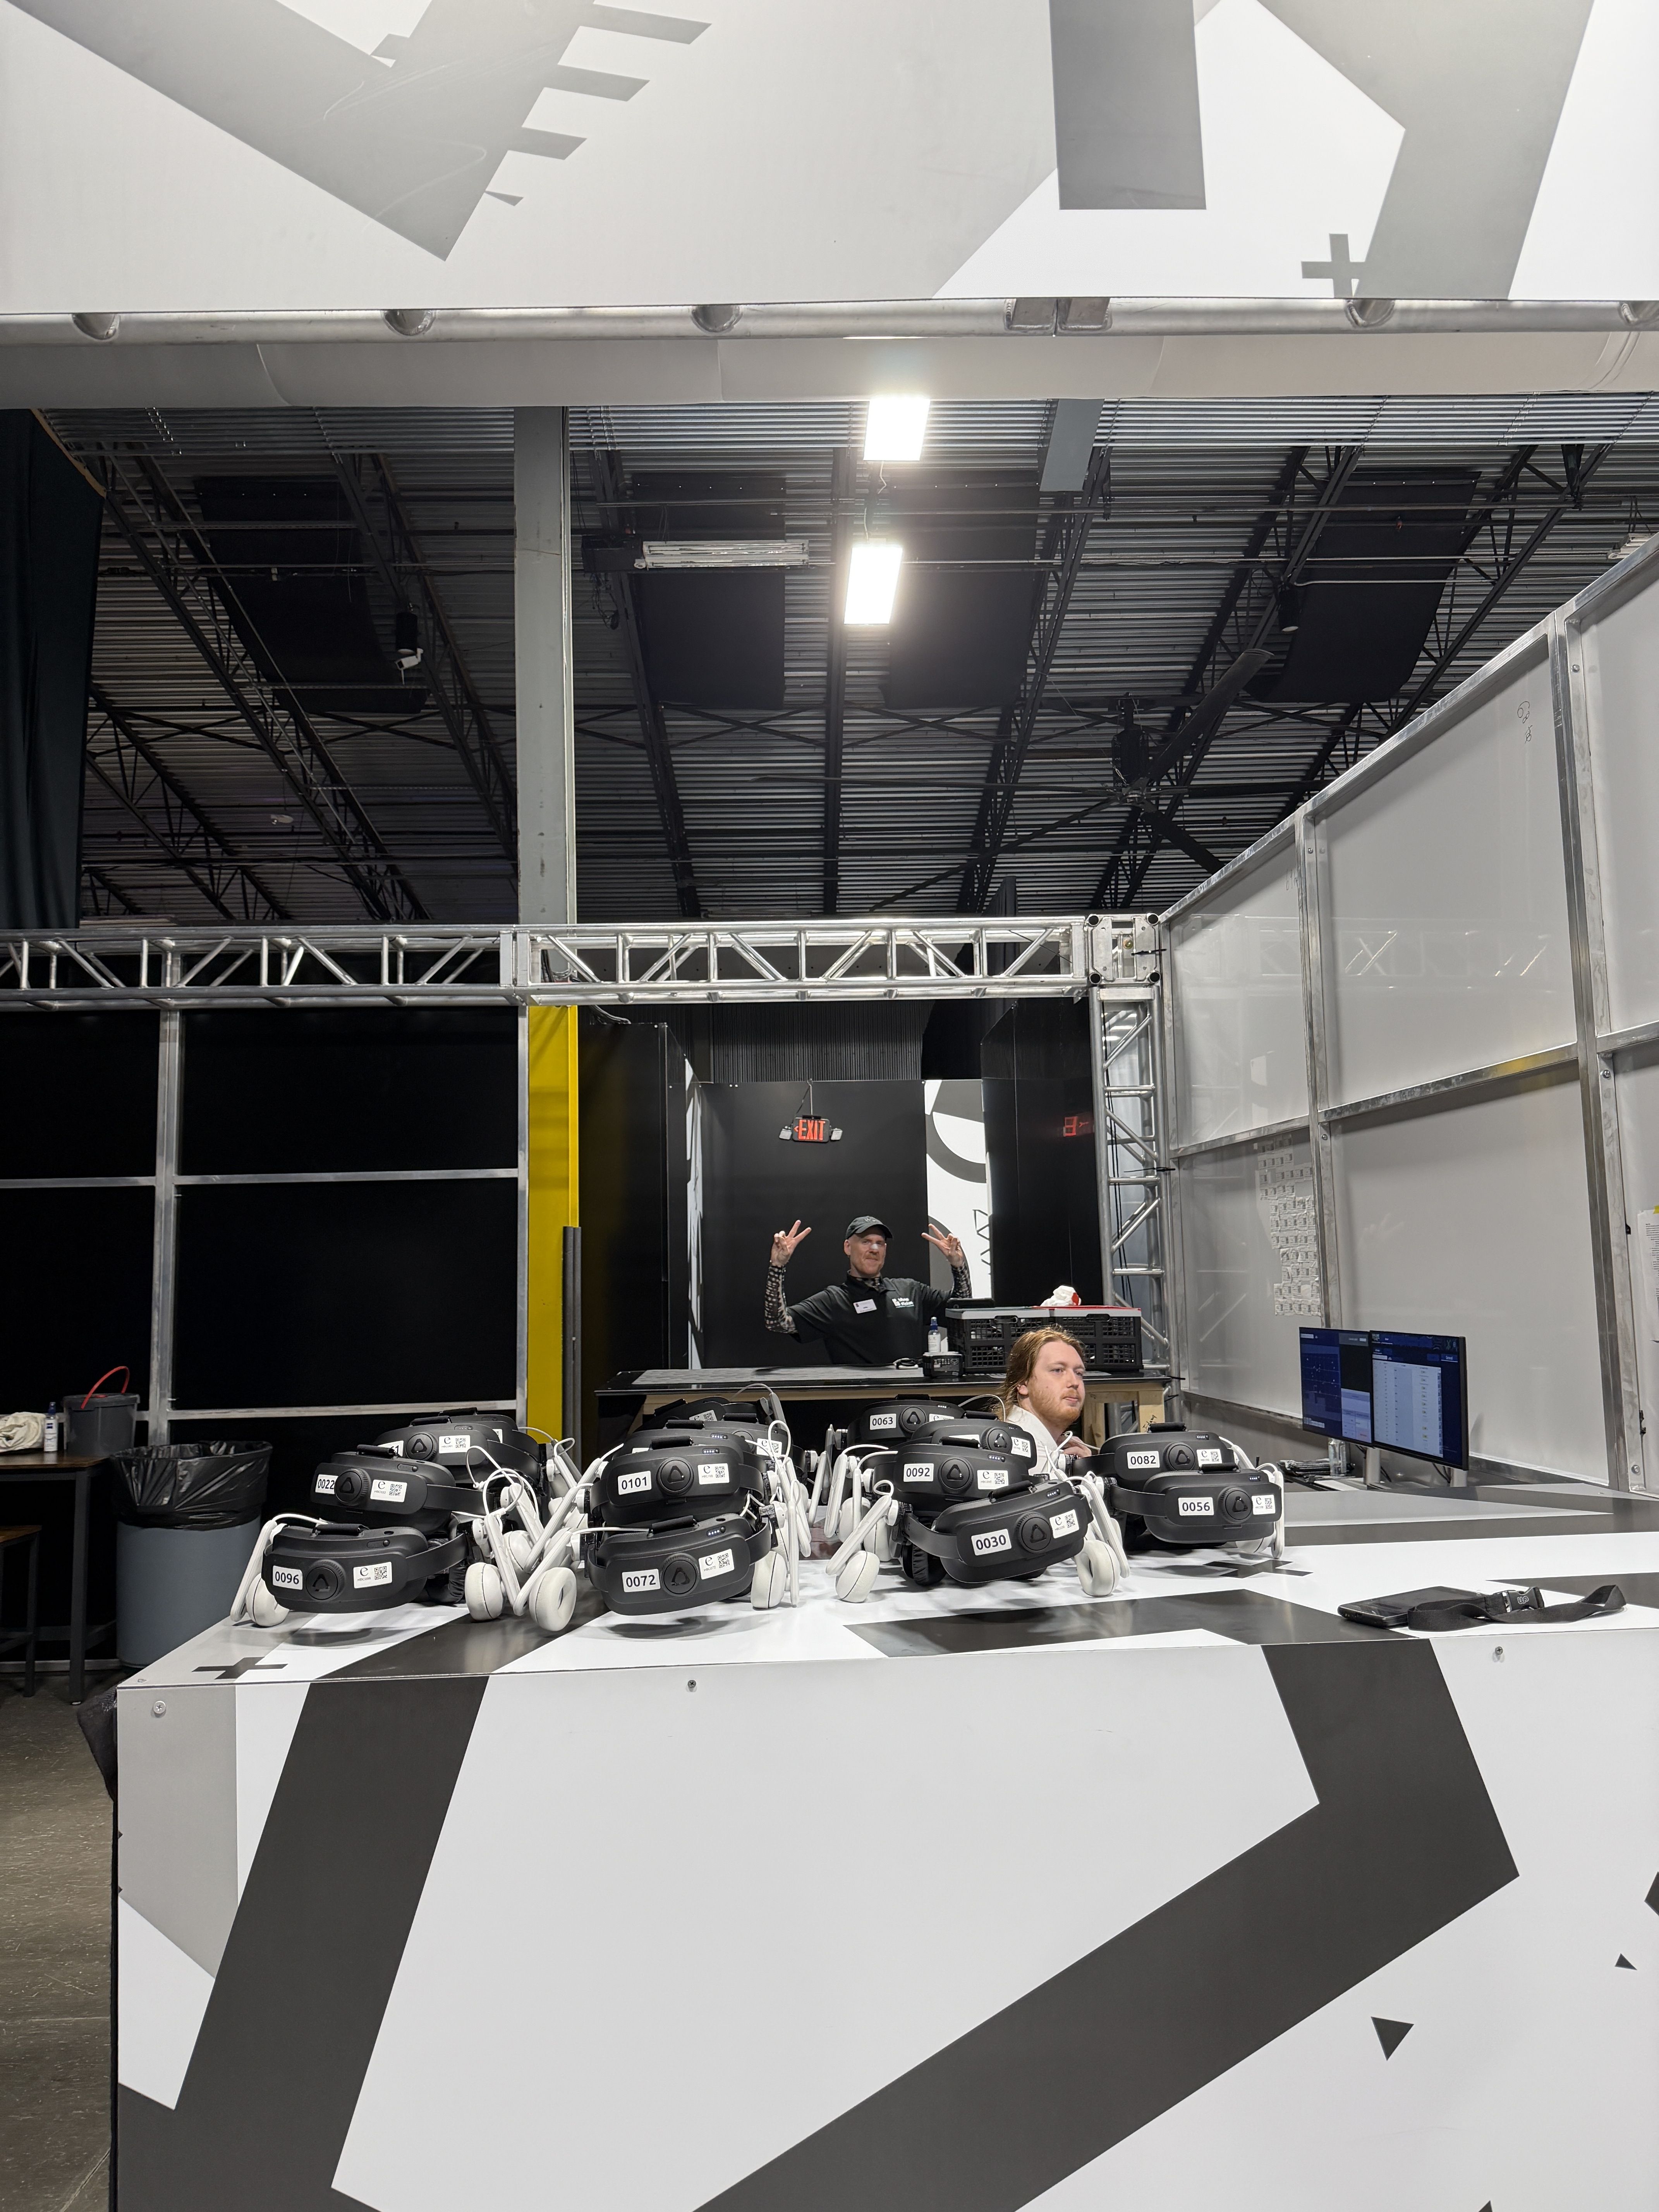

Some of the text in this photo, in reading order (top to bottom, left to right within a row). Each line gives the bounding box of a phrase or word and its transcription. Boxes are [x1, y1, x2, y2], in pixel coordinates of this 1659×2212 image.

[798, 1119, 826, 1140] EXIT
[872, 1417, 893, 1426] 0063
[1130, 1455, 1156, 1465] 0082
[906, 1467, 930, 1477] 0092
[318, 1479, 335, 1490] 0022
[621, 1476, 647, 1490] 0101
[1182, 1502, 1210, 1511] 0056
[976, 1534, 1006, 1550] 0030
[275, 1571, 299, 1585] 0096
[626, 1575, 656, 1588] 0072
